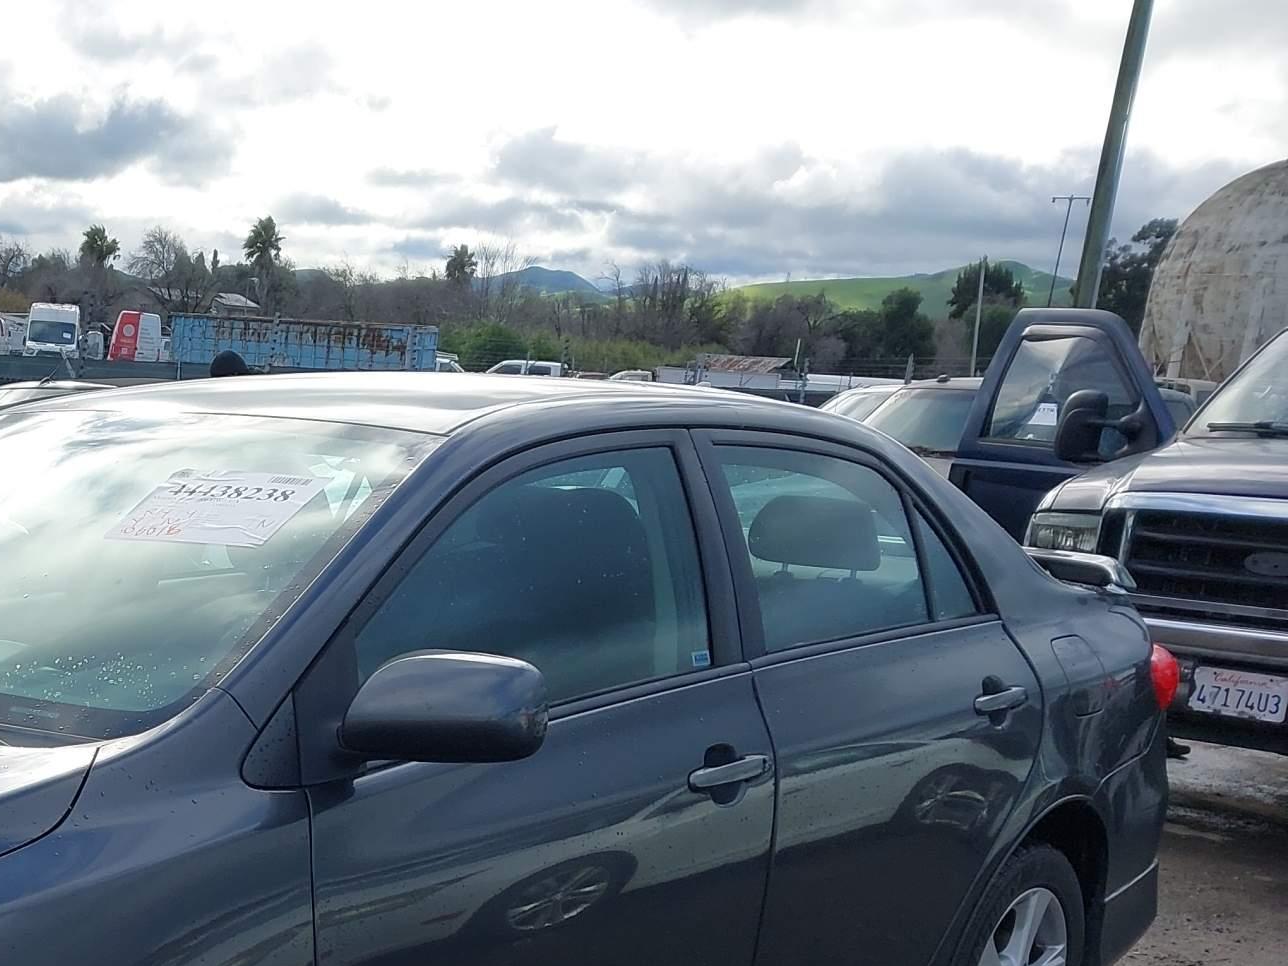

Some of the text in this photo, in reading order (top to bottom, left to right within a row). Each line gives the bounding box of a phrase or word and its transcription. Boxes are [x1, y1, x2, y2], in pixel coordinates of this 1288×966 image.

[168, 483, 296, 503] 44438238
[1214, 672, 1271, 689] California
[1196, 684, 1282, 715] 47174U3
